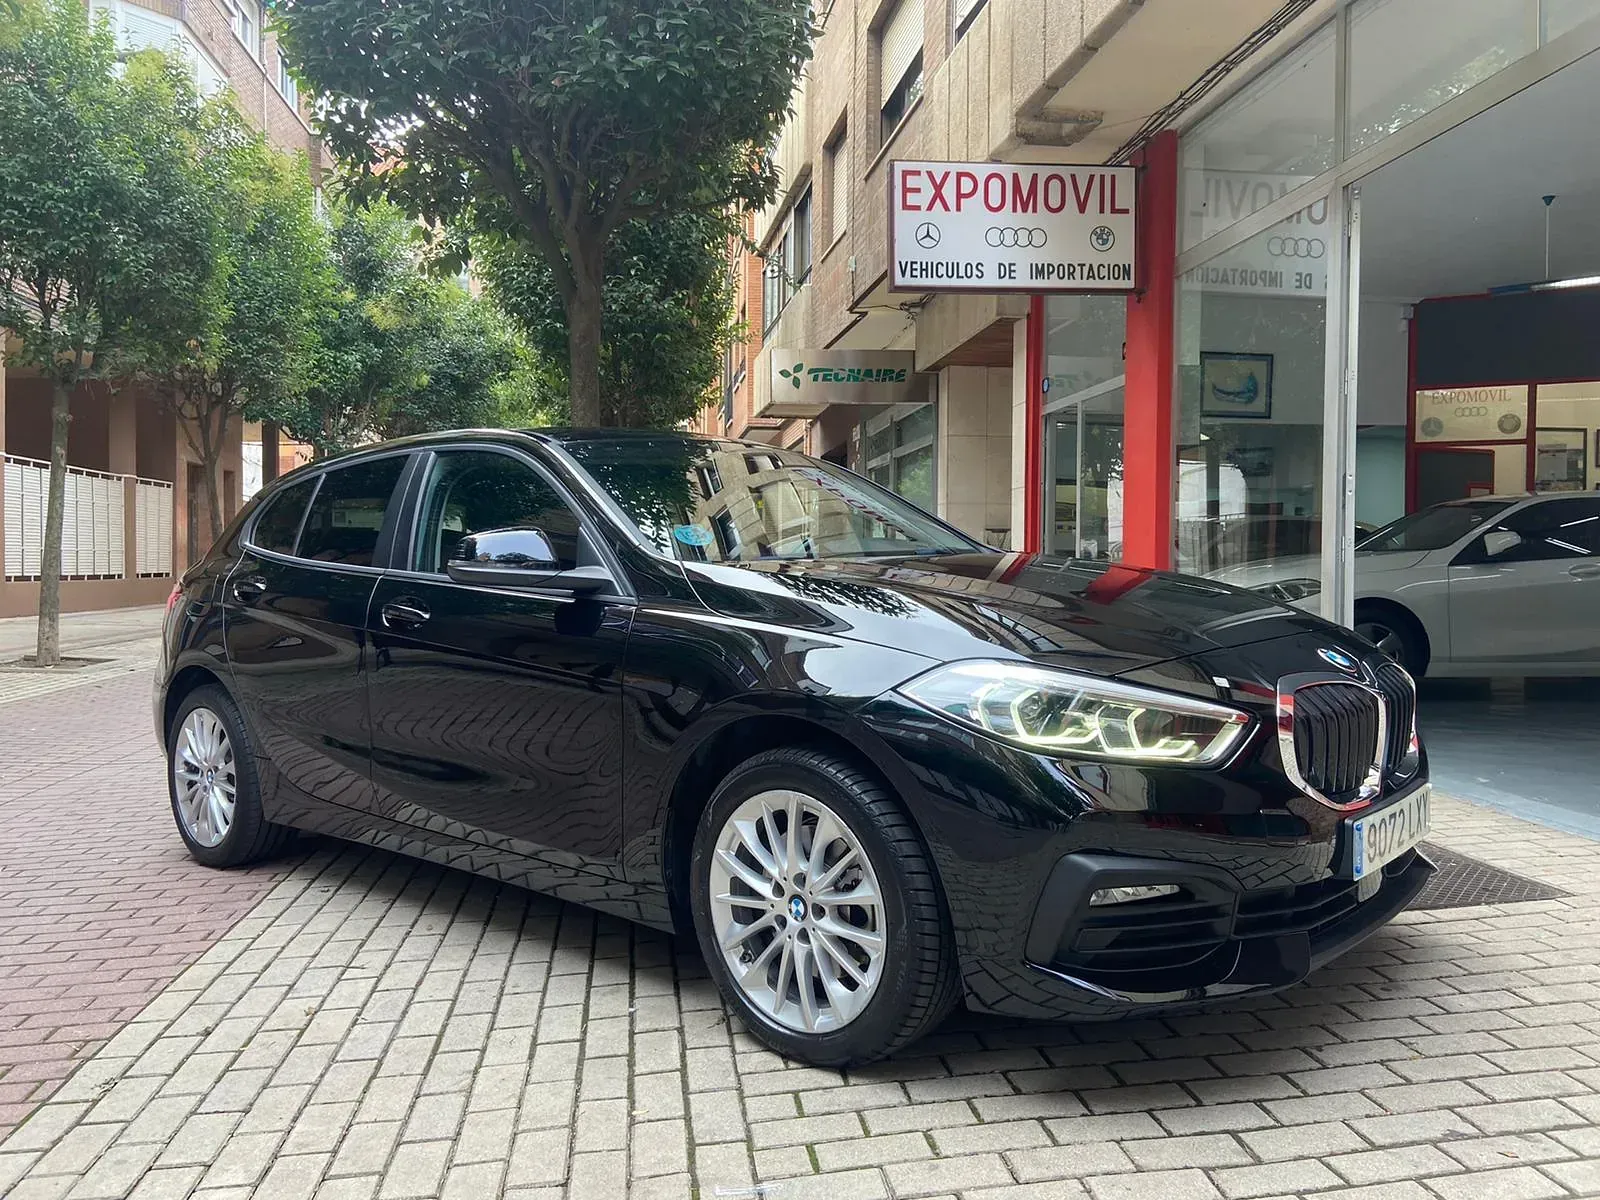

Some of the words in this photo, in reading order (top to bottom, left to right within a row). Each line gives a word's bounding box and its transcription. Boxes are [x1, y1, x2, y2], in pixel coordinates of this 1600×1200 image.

[901, 169, 1130, 215] EXPOMOVIL
[898, 260, 985, 279] VEHICULOS
[998, 262, 1017, 280] DE
[1029, 263, 1132, 281] IMPORTACION
[807, 367, 907, 383] TECNAIRE
[1431, 388, 1512, 405] EXPOMOVIL
[1367, 808, 1406, 864] 9072
